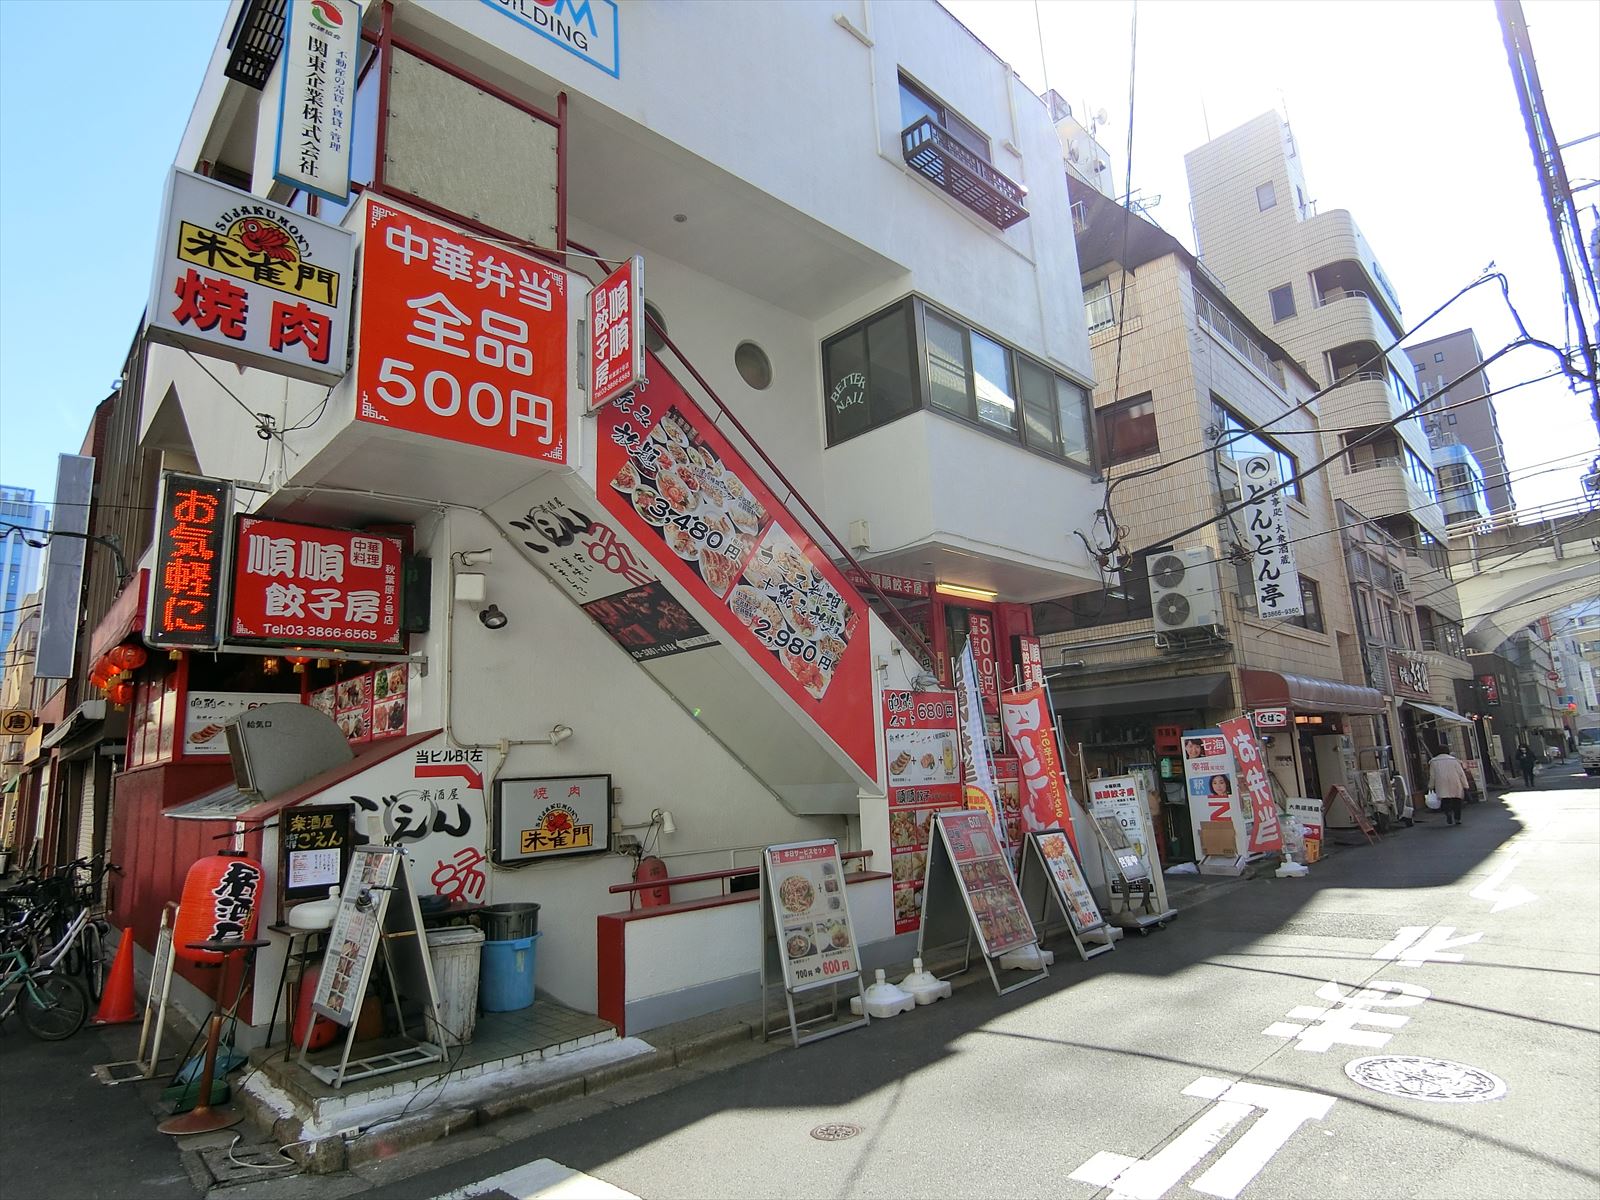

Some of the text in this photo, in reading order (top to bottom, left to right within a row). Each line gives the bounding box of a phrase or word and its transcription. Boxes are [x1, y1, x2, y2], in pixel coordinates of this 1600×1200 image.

[298, 36, 328, 179] 関東企業株式会社
[184, 230, 334, 304] 朱雀門
[385, 224, 553, 313] 中華弁当
[172, 268, 333, 365] 焼肉
[405, 291, 534, 377] 全品
[376, 357, 554, 446] 500円
[830, 372, 866, 403] BETTER
[835, 391, 864, 414] NAIL
[352, 539, 381, 553] 中華
[649, 496, 741, 561] 3,480円
[1246, 484, 1285, 608] とんとん亭
[163, 489, 219, 632] お気軽に
[247, 534, 345, 583] 順順
[352, 551, 381, 566] 料理
[265, 582, 381, 624] 餃子房
[262, 623, 378, 640] Tel:03-3866-6565
[753, 618, 832, 671] 2,980円
[8, 713, 26, 729] 唐
[917, 702, 954, 719] 680円
[415, 749, 484, 764] 当ビルB1左
[533, 784, 581, 801] 焼肉
[1233, 729, 1279, 845] お弁当
[290, 814, 334, 832] 楽酒屋
[523, 825, 591, 851] 朱雀門
